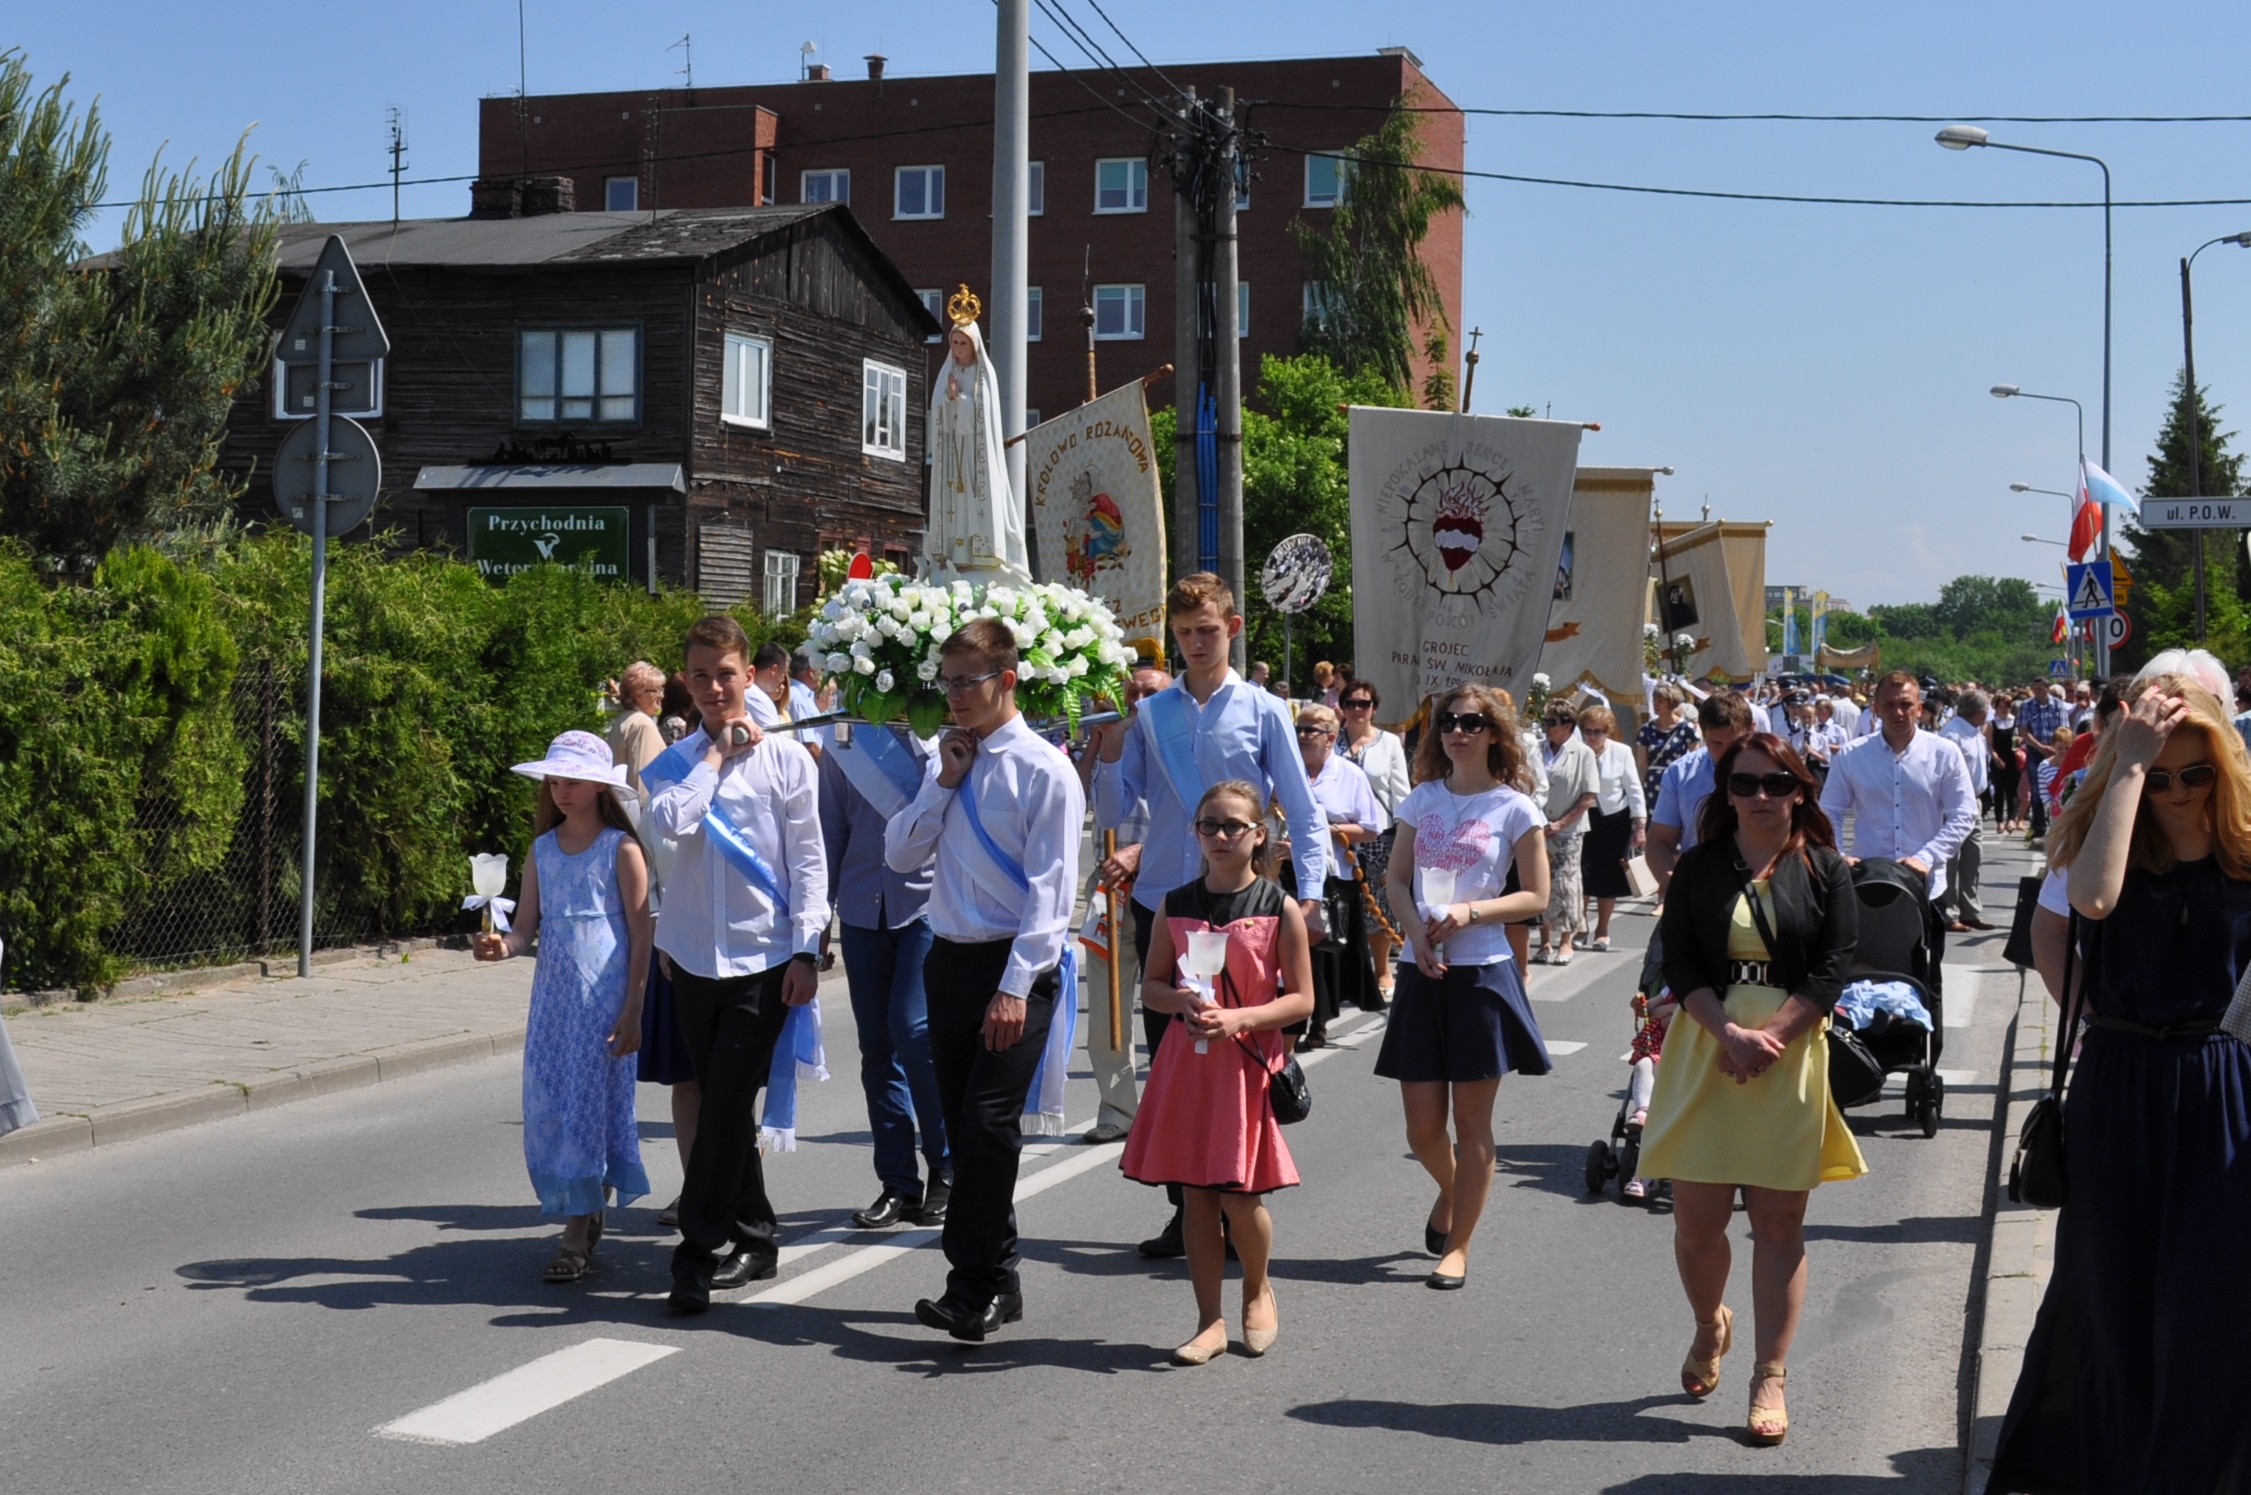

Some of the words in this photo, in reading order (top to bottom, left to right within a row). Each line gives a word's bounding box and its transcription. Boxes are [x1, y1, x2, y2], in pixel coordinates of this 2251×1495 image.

[1465, 441, 1510, 471] SERCE
[2167, 506, 2184, 521] ul.
[2189, 505, 2236, 520] P.O.W.
[488, 514, 605, 536] Przychodnia
